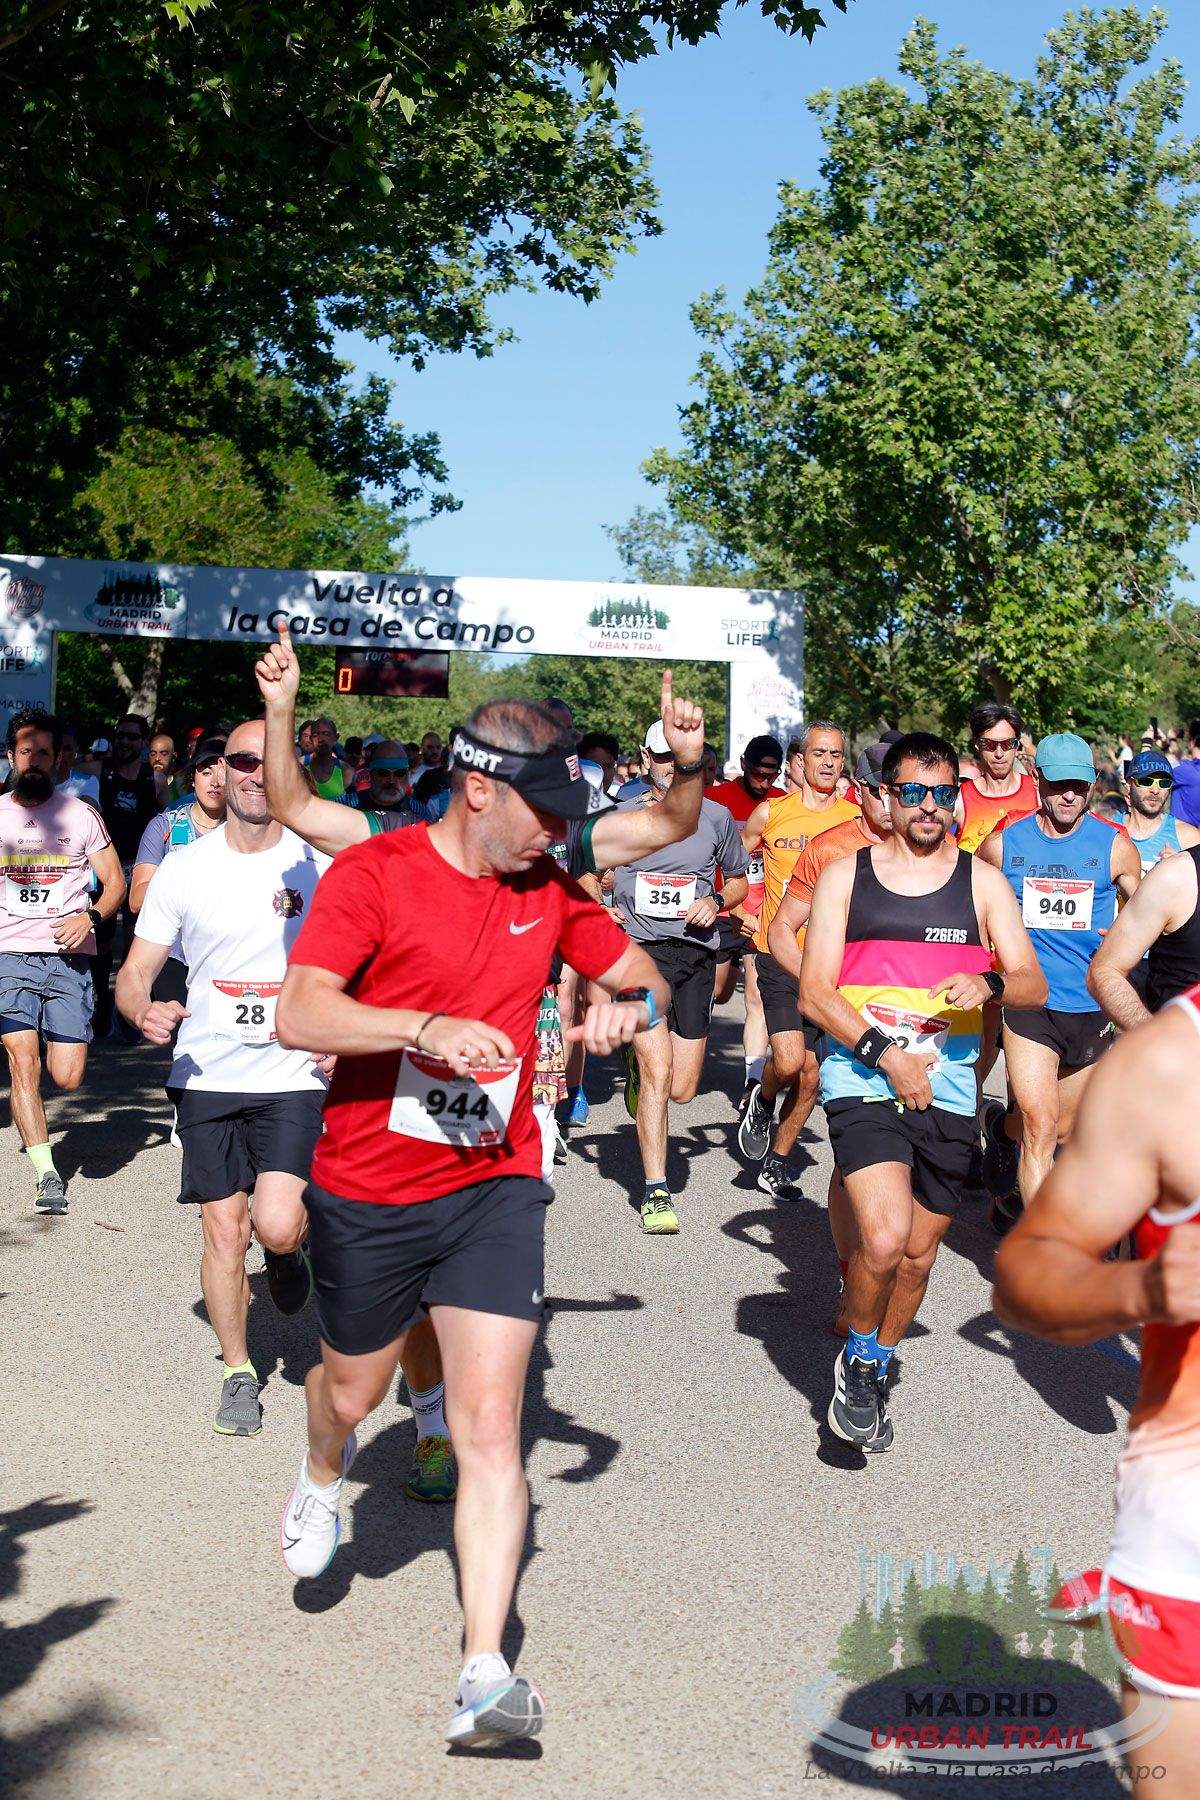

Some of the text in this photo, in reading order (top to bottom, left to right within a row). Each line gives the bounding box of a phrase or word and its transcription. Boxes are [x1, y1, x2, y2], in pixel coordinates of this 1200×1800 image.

[312, 578, 454, 607] Vuelta a
[109, 608, 161, 619] MADRID
[97, 618, 173, 631] URBAN TRAIL
[227, 607, 535, 648] la Casa de Campo
[721, 619, 768, 631] SPORT
[601, 630, 652, 640] MADRID
[727, 633, 761, 646] LIFE
[0, 645, 31, 657] ORT
[589, 640, 663, 652] URBAN TRAIL
[0, 658, 25, 671] IFE
[453, 733, 502, 772] PORT
[20, 889, 51, 903] 857
[650, 890, 681, 906] 354
[1040, 898, 1076, 916] 940
[925, 927, 967, 943] 226ERS
[235, 1004, 265, 1025] 28
[427, 1089, 489, 1121] 944
